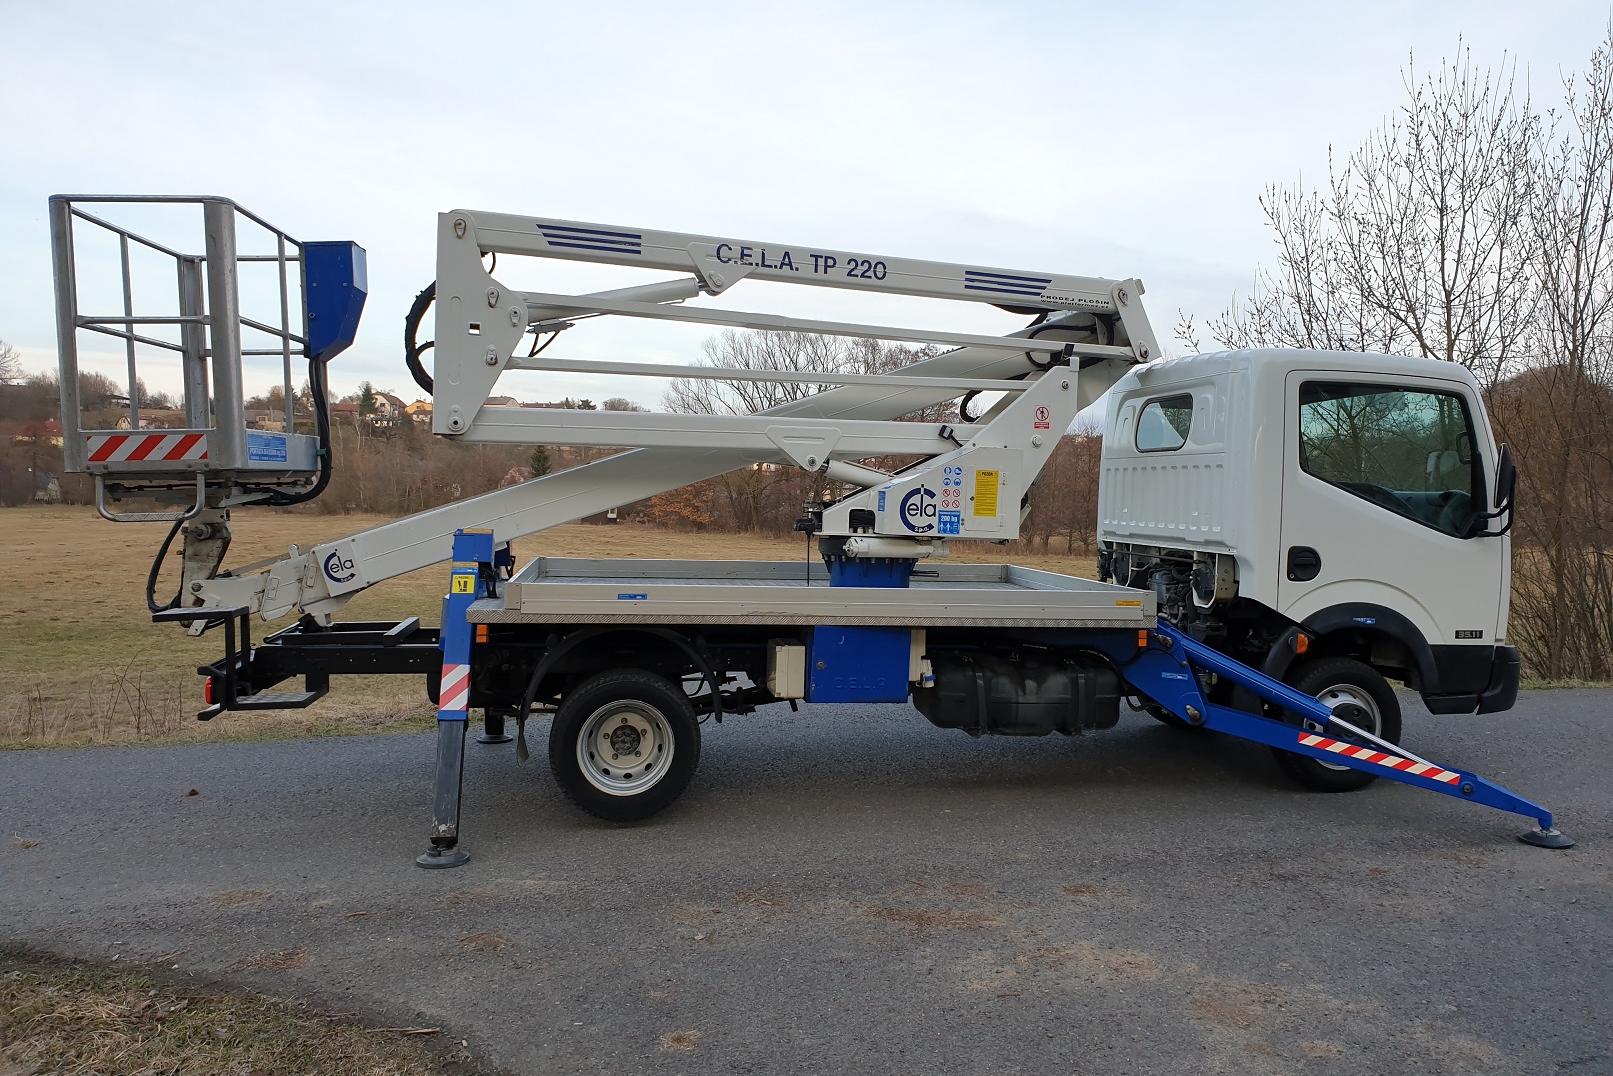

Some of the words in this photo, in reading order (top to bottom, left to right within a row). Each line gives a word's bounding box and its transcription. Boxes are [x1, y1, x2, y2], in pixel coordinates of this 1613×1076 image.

[716, 243, 799, 272] C.E.L.A.
[809, 253, 837, 275] TP
[846, 258, 887, 281] 220
